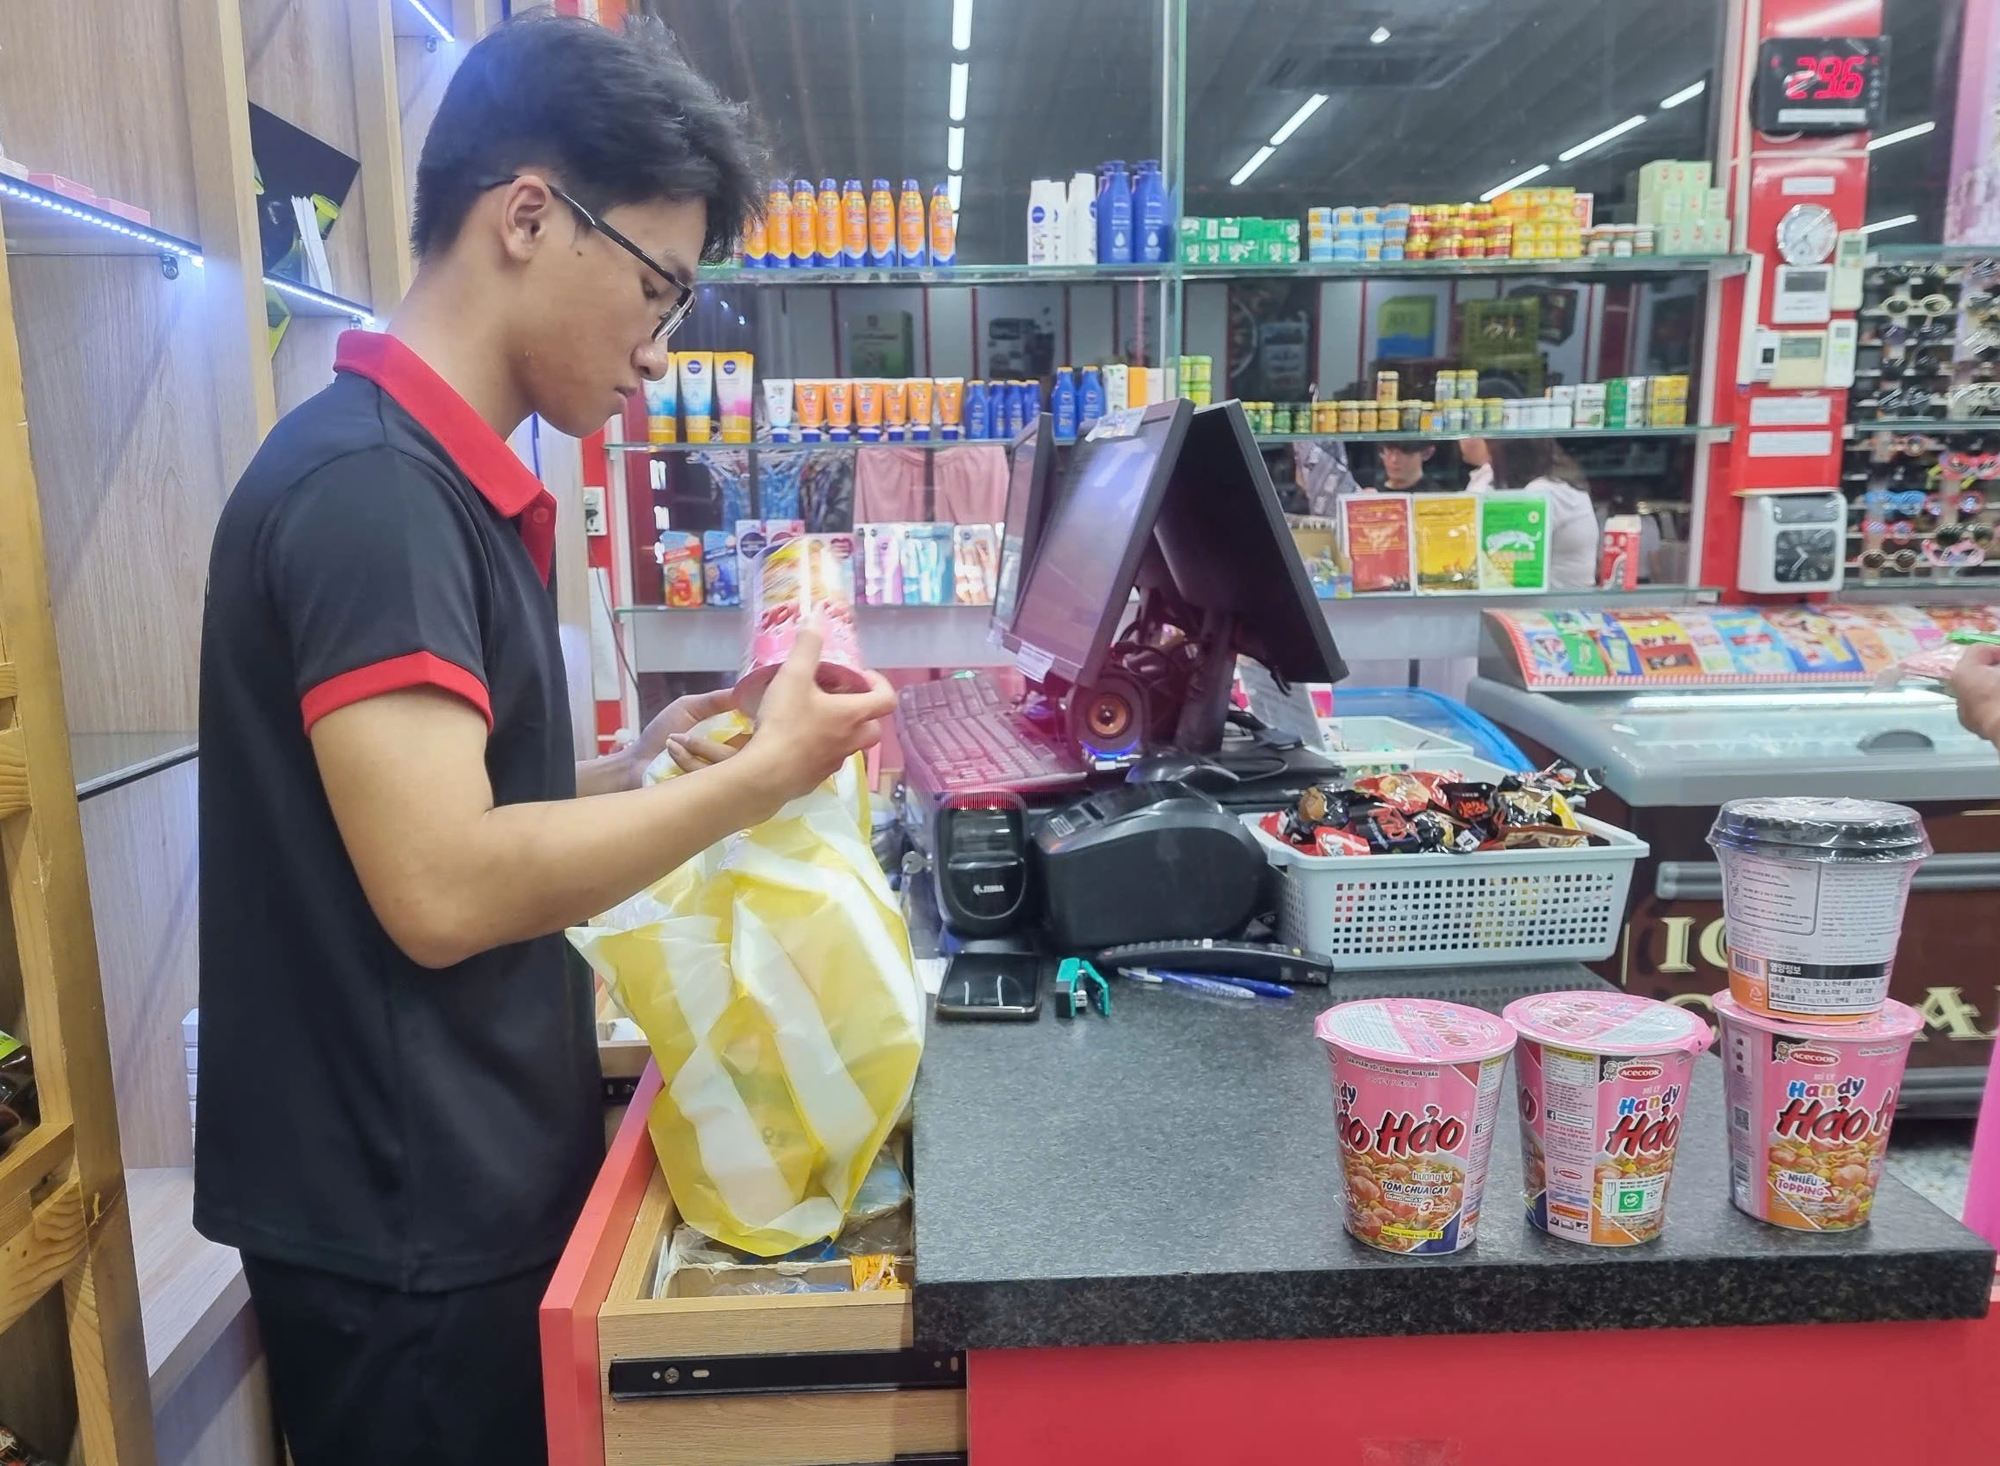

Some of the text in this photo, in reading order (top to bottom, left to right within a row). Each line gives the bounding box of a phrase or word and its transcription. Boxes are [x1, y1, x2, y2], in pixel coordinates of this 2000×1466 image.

[1618, 1083, 1680, 1116] Handy
[1788, 1076, 1865, 1099] Handy
[1337, 1099, 1373, 1154] ảo
[1376, 1105, 1465, 1157] Hảo
[1606, 1105, 1679, 1157] Hảo
[1776, 1096, 1870, 1143] Hảo
[1404, 1185, 1429, 1195] CHUA
[1432, 1186, 1450, 1195] CAY
[1412, 1171, 1441, 1183] hương
[1420, 1201, 1432, 1212] 3
